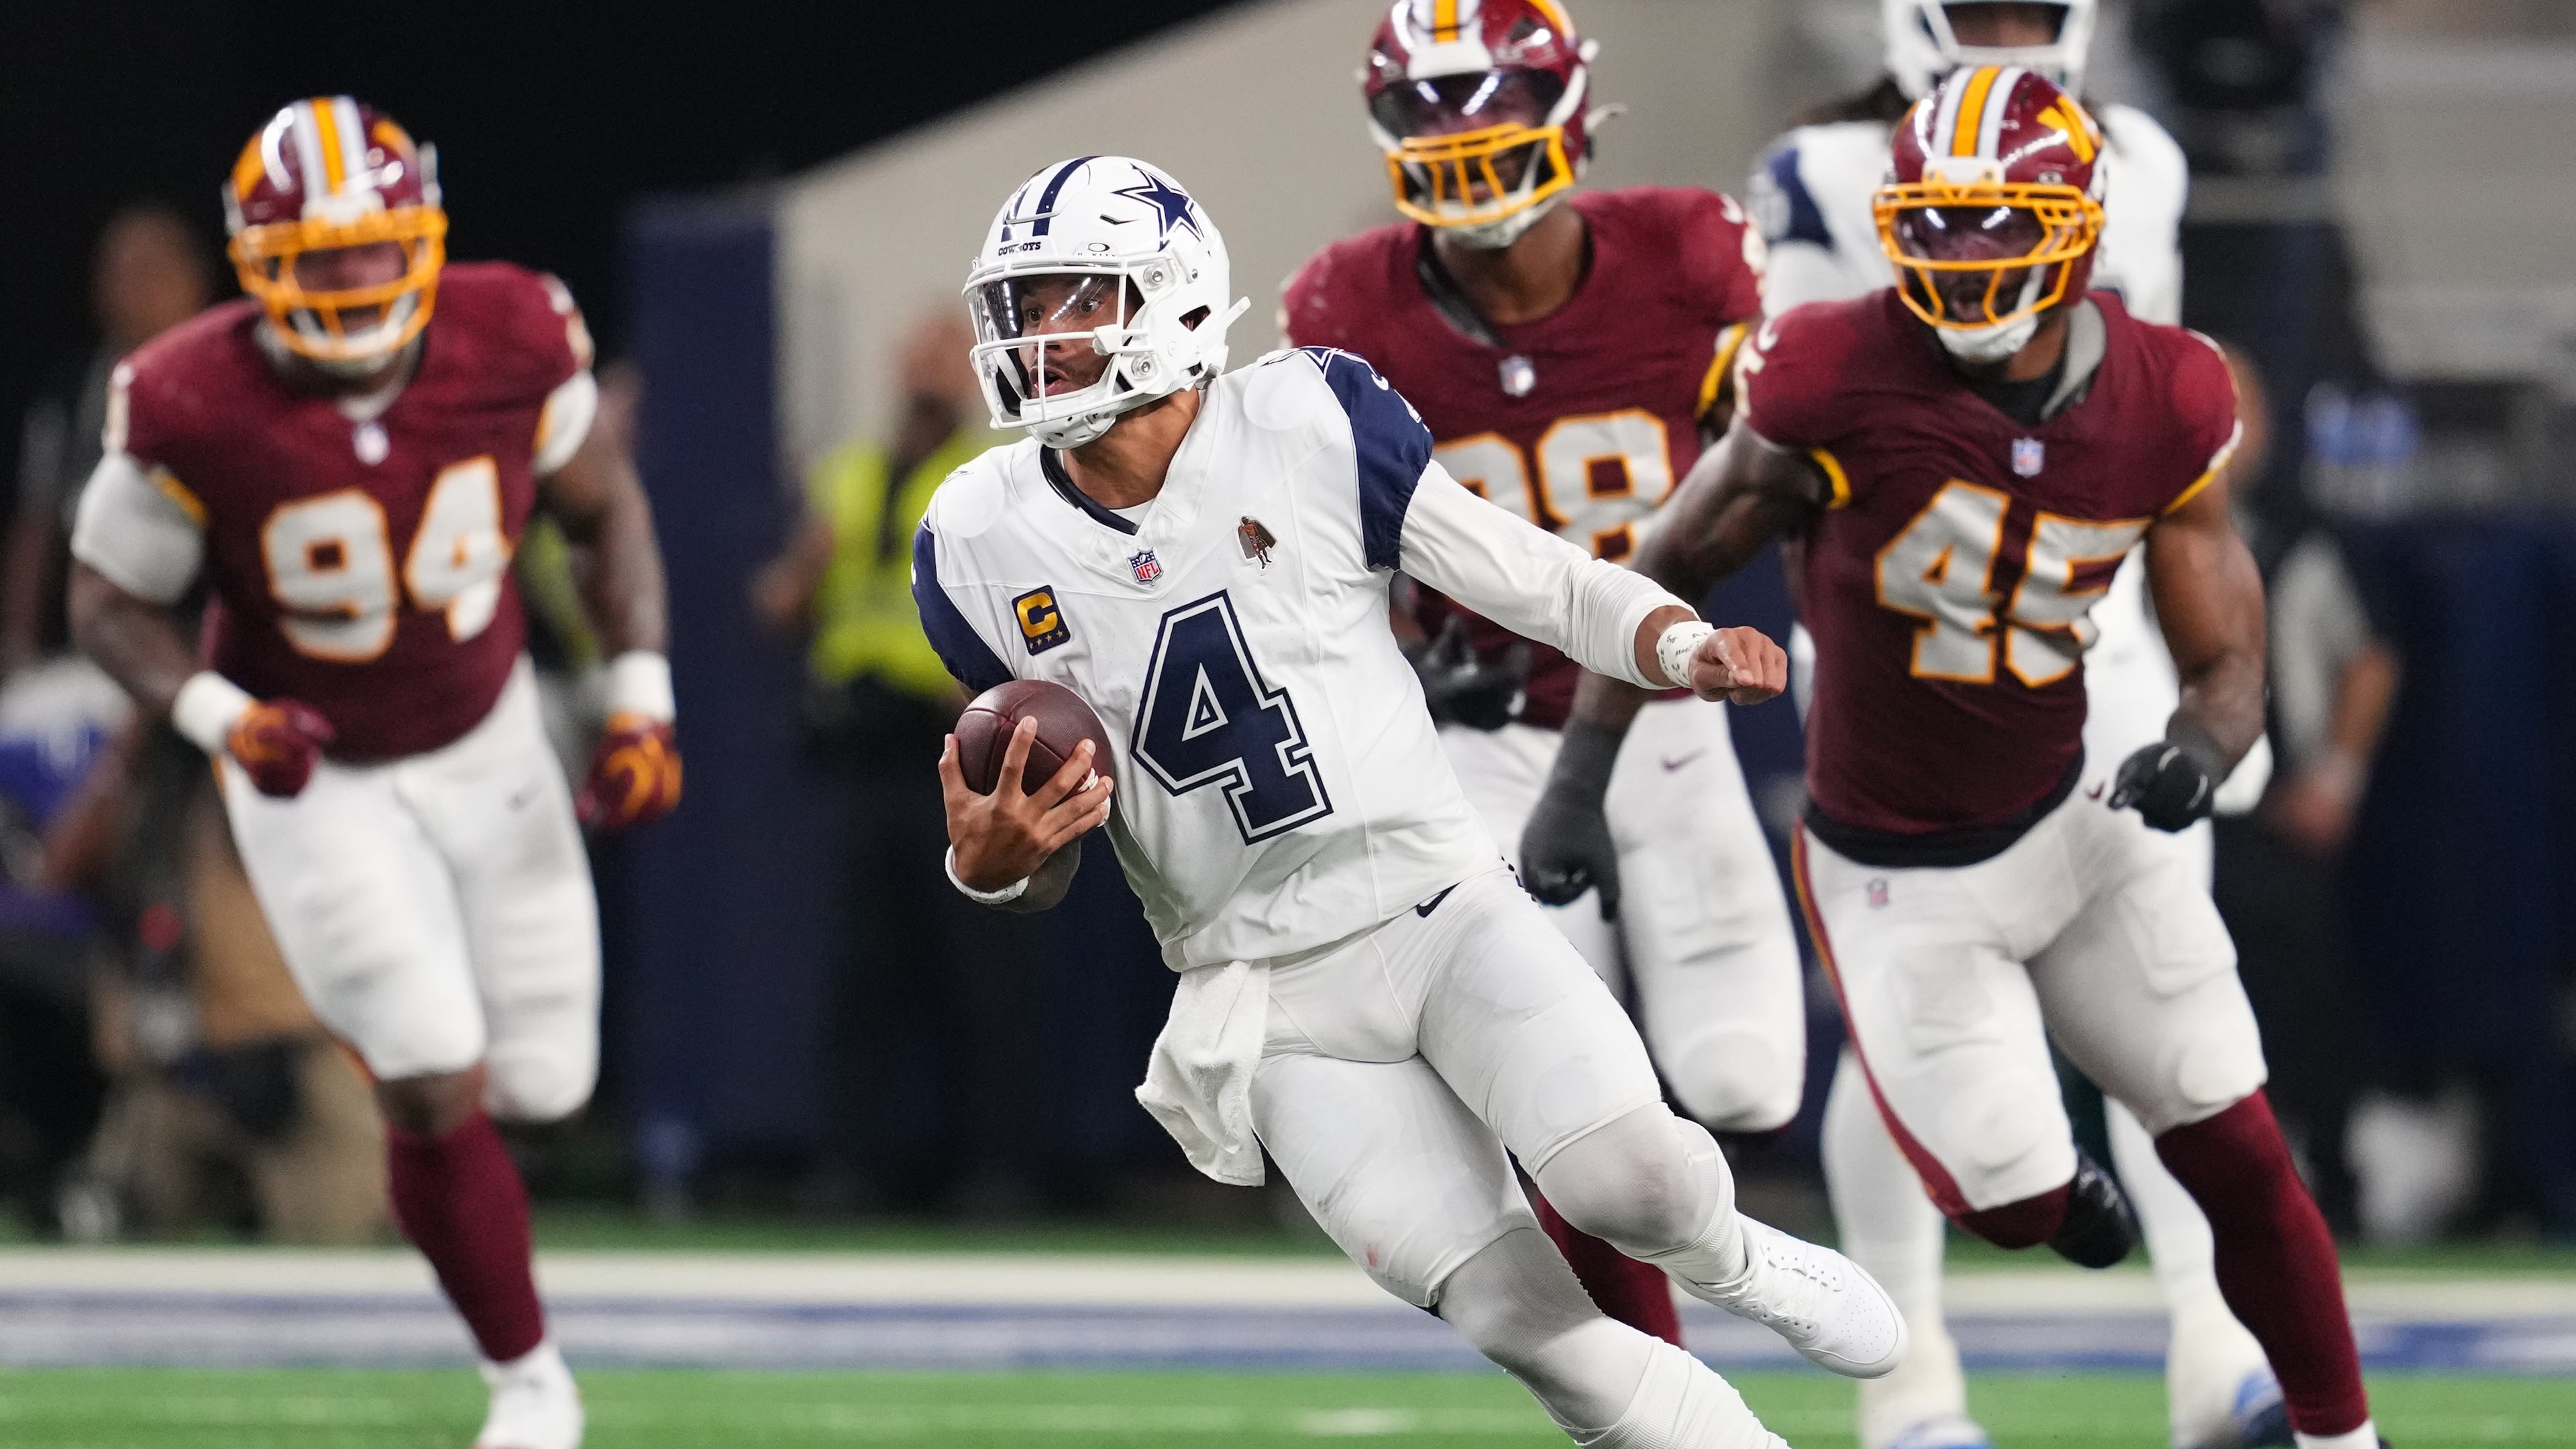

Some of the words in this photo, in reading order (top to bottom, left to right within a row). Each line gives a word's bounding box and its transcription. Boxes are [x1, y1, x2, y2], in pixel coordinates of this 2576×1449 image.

[998, 241, 1041, 256] COWOYS
[260, 453, 515, 664] 94
[1016, 592, 1059, 639] C
[1136, 562, 1159, 580] NFL
[1874, 477, 2152, 689] 45
[1130, 588, 1334, 846] 4
